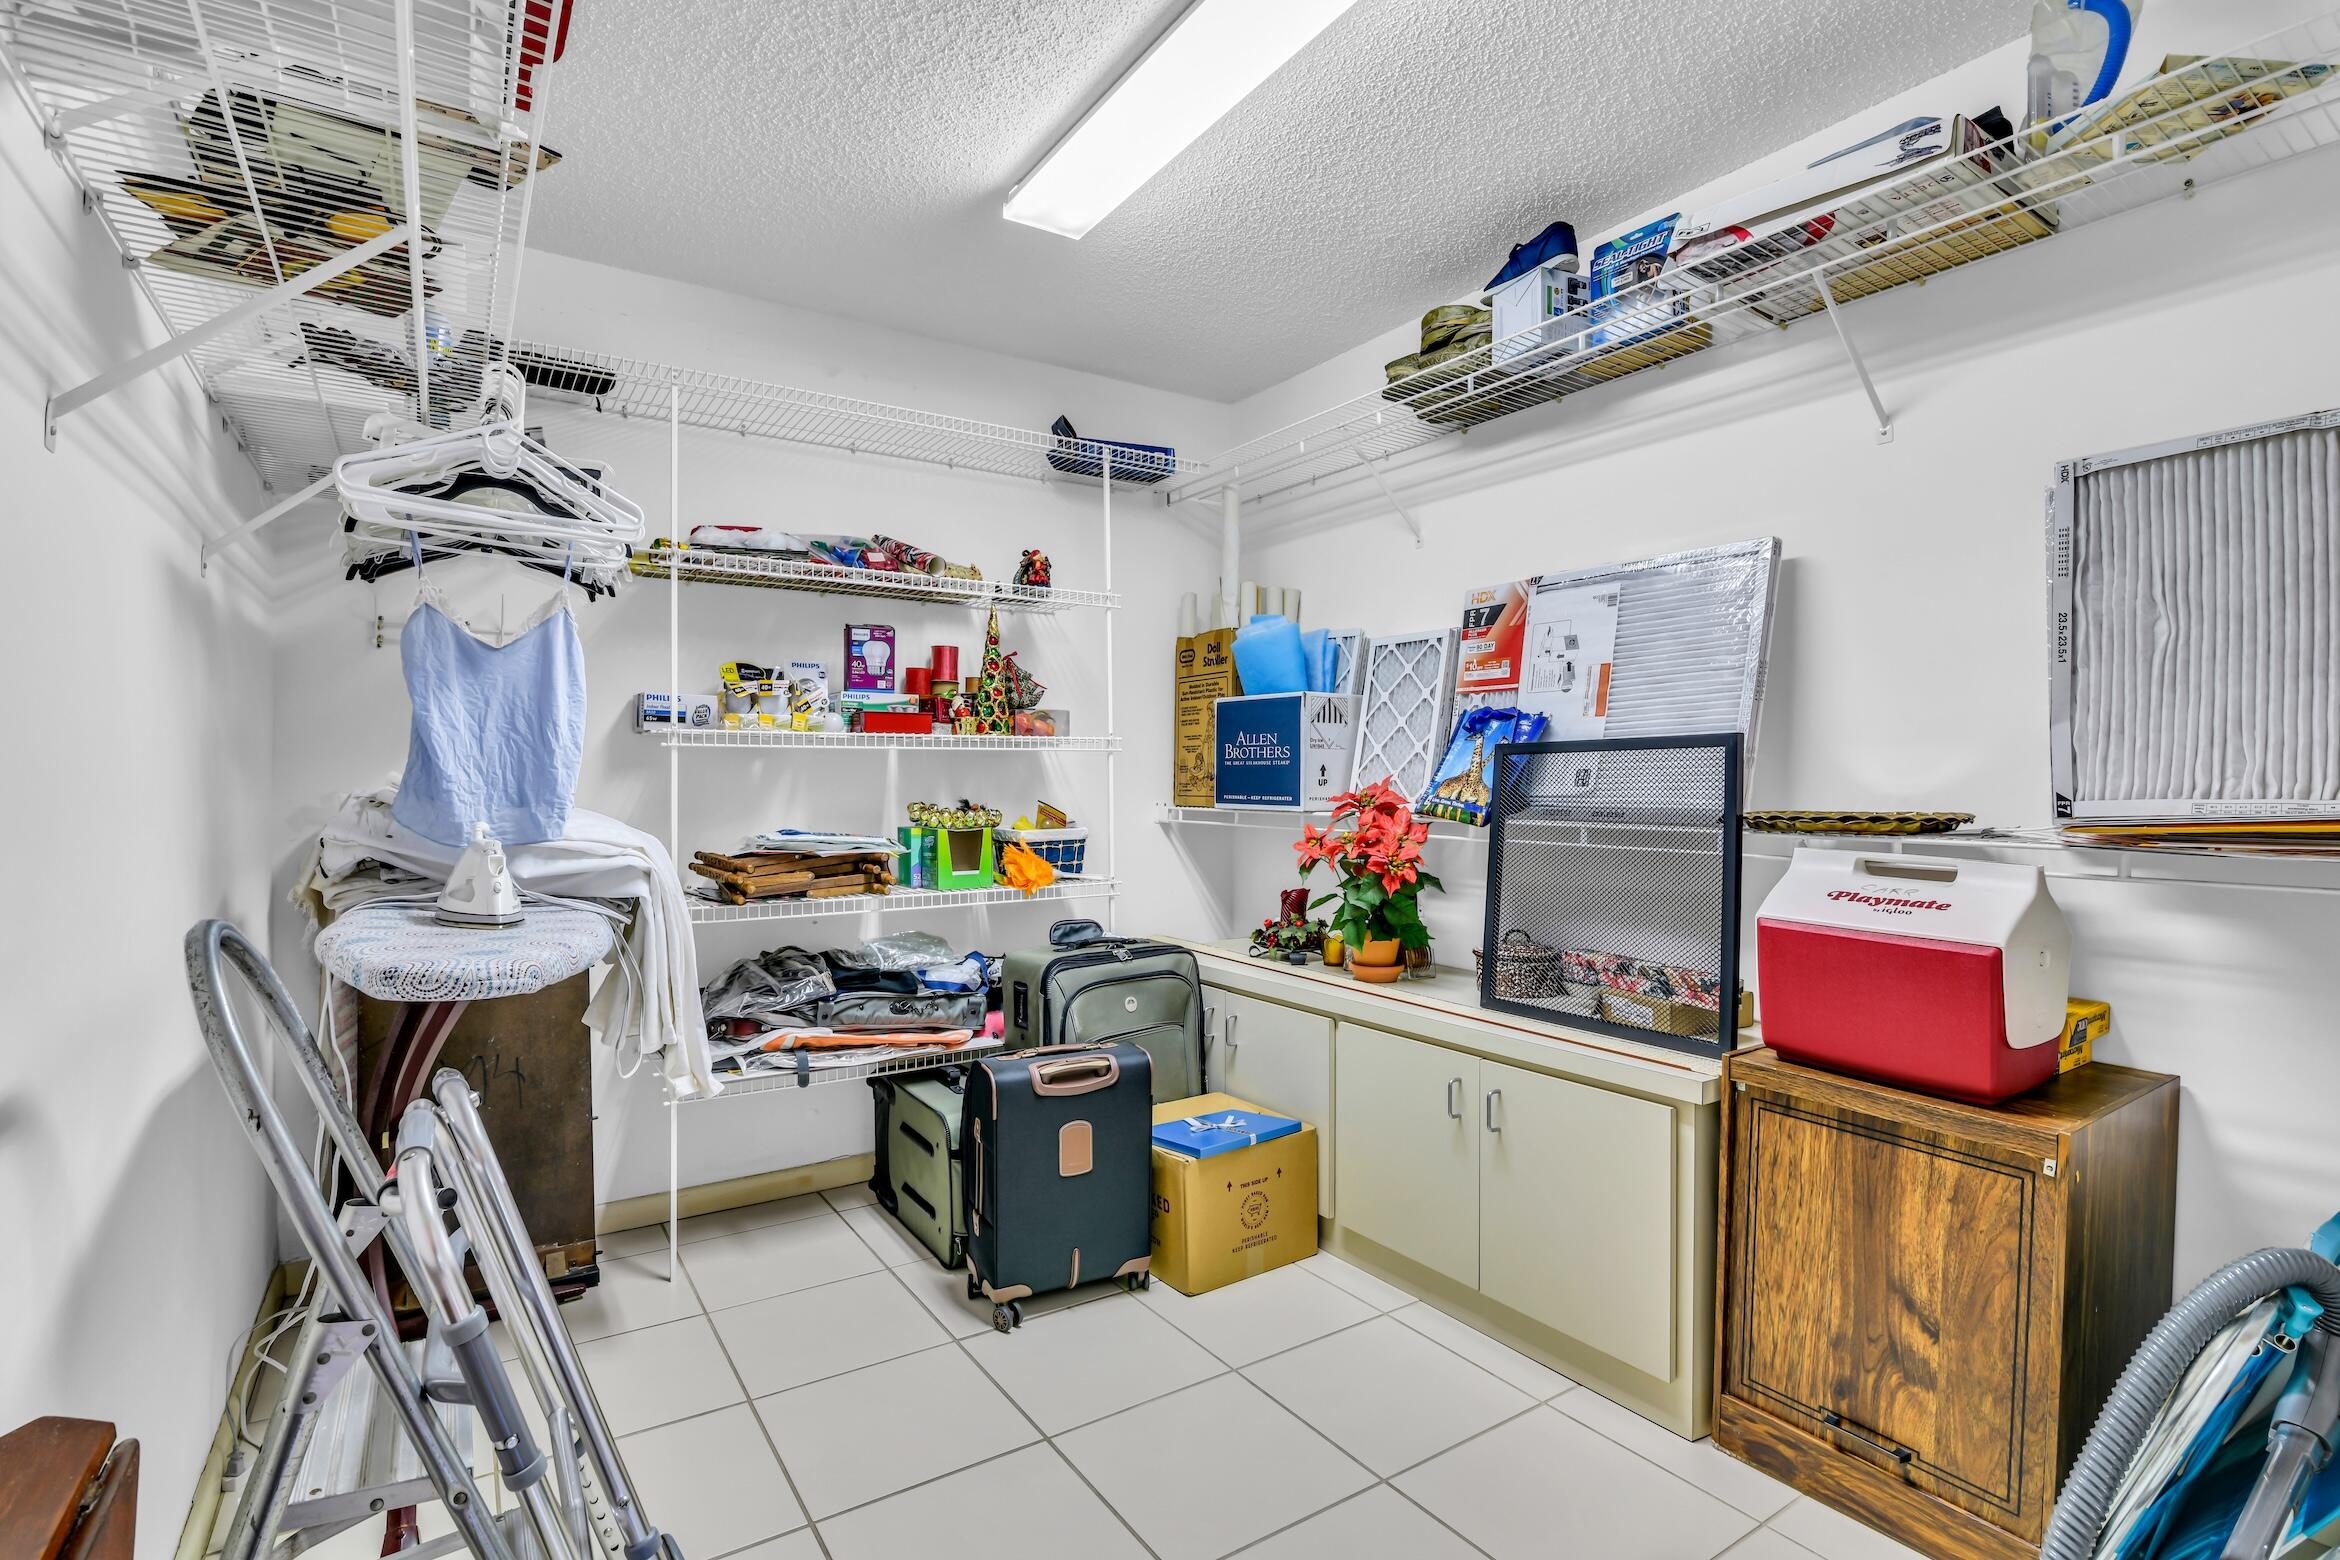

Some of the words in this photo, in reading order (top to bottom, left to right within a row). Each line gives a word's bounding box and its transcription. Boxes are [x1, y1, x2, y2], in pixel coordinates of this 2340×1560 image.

[1592, 231, 1669, 272] SEAL-TIGHT
[2060, 464, 2070, 484] HDX
[1471, 590, 1497, 605] HDX
[1468, 608, 1477, 628] FPR
[1479, 607, 1491, 627] 7
[1207, 641, 1221, 654] Doll
[722, 666, 735, 674] LED
[646, 694, 681, 703] PHILIS
[842, 692, 871, 700] PHILIPS
[1235, 730, 1278, 746] ALLEN
[1225, 743, 1291, 759] BROTHERS
[1318, 779, 1328, 787] UP
[1826, 890, 1952, 911] Playmate
[1881, 906, 1913, 915] igloo
[1240, 1180, 1250, 1189] THIS
[1250, 1178, 1261, 1187] SIDE
[1152, 1192, 1170, 1214] KED
[1241, 1231, 1268, 1244] PERISHABLE
